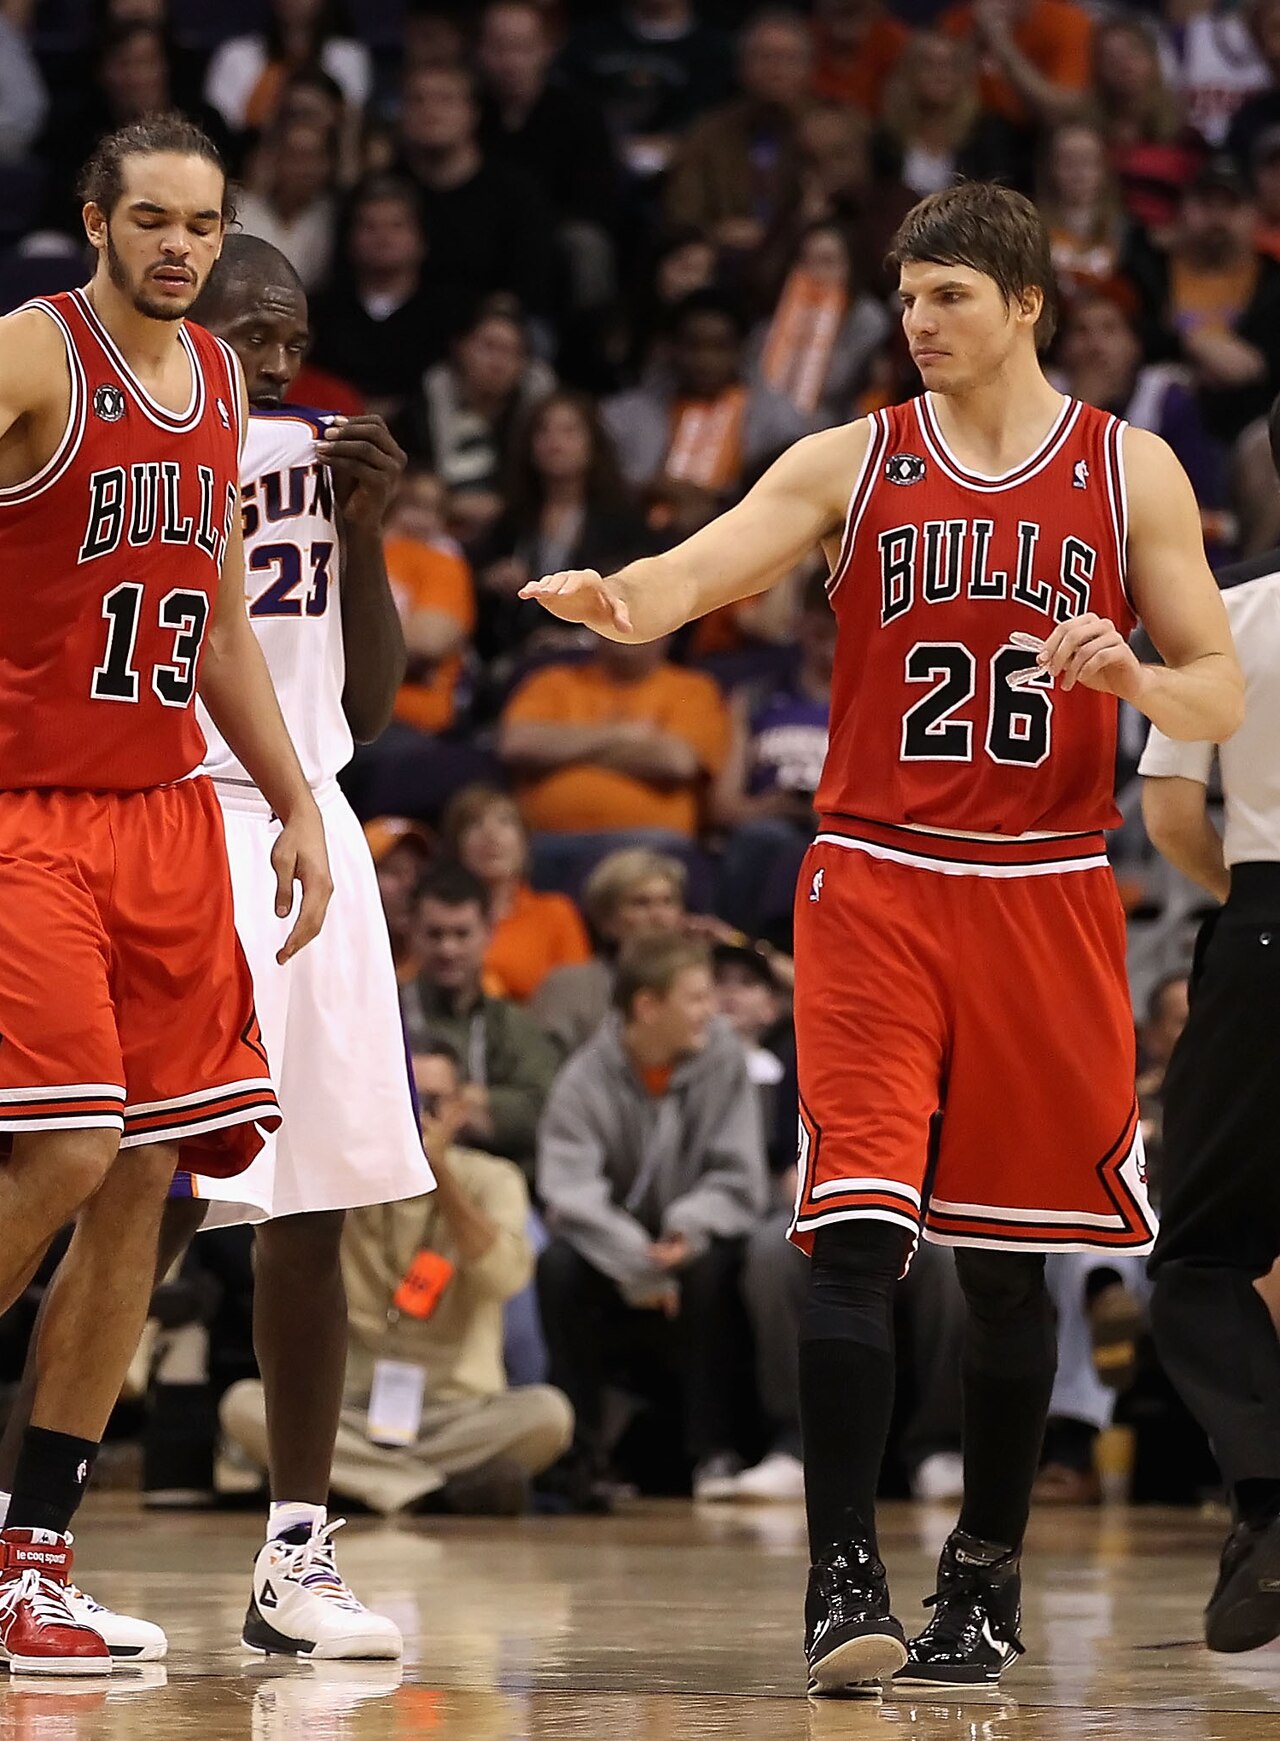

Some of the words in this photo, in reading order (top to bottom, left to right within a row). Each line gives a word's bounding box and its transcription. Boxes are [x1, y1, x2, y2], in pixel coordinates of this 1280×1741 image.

[248, 541, 335, 620] 23
[877, 518, 1097, 629] BULLS
[91, 581, 210, 708] 13
[899, 640, 1055, 769] 26
[16, 1550, 26, 1560] le
[26, 1551, 45, 1564] coq
